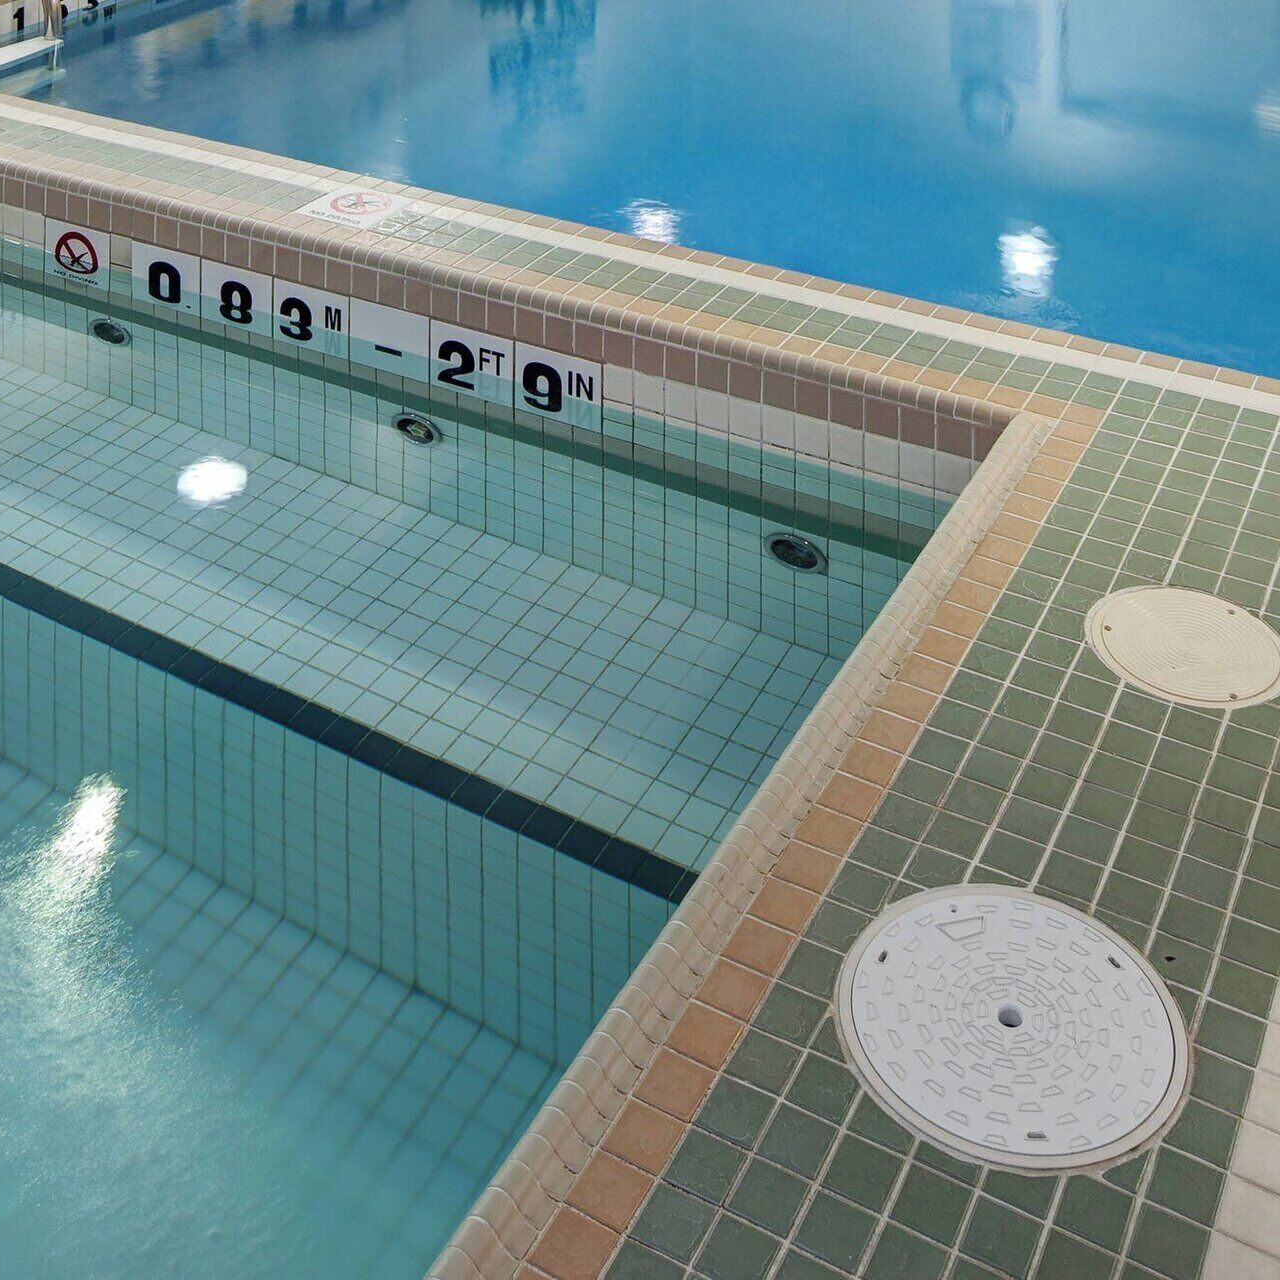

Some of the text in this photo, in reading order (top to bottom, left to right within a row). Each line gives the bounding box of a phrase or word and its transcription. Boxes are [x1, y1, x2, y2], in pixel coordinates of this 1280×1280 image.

[328, 213, 361, 225] DIVING
[53, 269, 98, 286] NO DIVING
